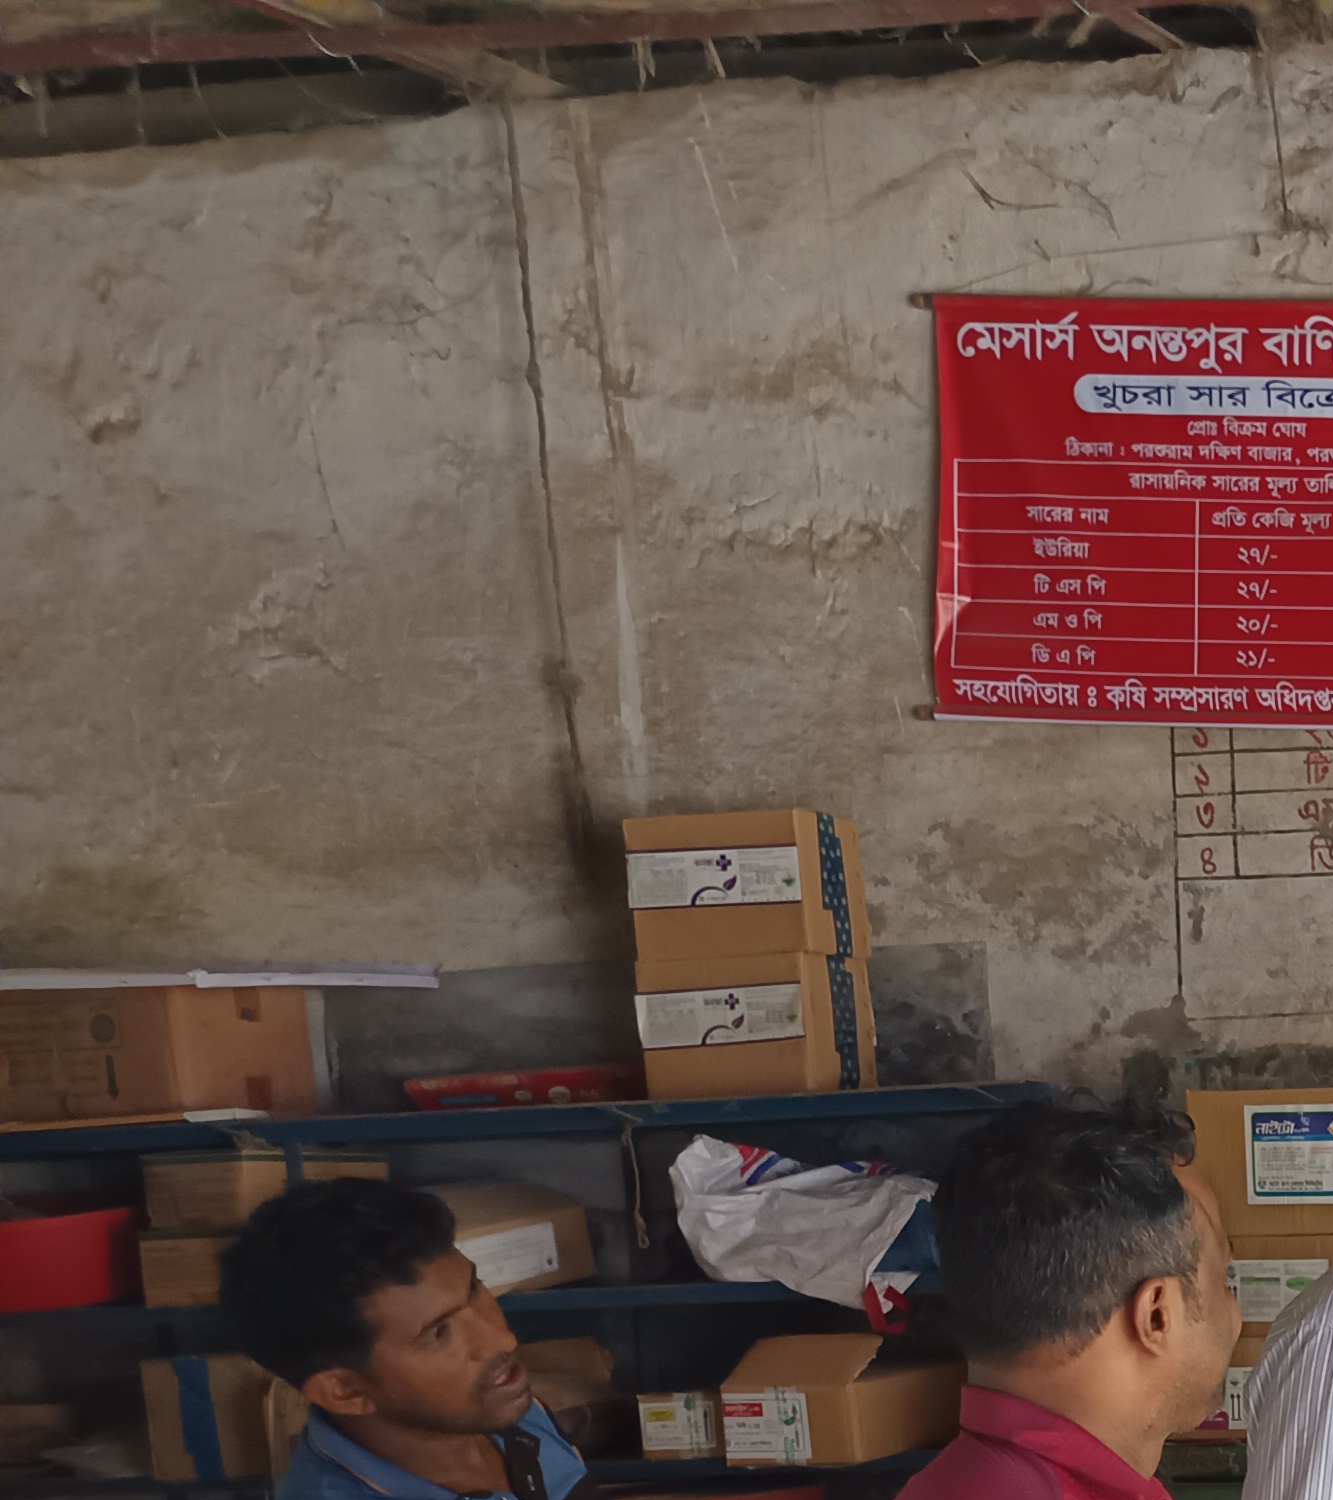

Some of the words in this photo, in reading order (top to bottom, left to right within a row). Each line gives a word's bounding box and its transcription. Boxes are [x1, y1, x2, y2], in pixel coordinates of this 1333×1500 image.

[957, 311, 1080, 361] মেসার্স
[1089, 323, 1250, 374] অনন্তপুর
[1094, 382, 1175, 411] খুচরা
[1187, 384, 1250, 408] সার
[1198, 440, 1241, 461] দক্ষিণ
[1212, 475, 1259, 492] সারের
[1266, 476, 1299, 498] মূল্য
[1026, 505, 1073, 523] সারের
[1080, 507, 1110, 524] নাম
[1212, 506, 1246, 528] প্রতি
[1252, 508, 1296, 529] কেজি
[1301, 513, 1331, 534] মূল্য
[1033, 536, 1090, 559] ইউরিয়া
[1237, 545, 1278, 566] ২৭/-
[1033, 573, 1050, 594] টি
[1056, 578, 1082, 595] এস
[1087, 574, 1106, 596] পি
[1237, 579, 1277, 600] ২৭/-
[1033, 611, 1058, 629] এম
[1065, 613, 1078, 628] ও
[1083, 608, 1102, 630] পি
[1236, 614, 1278, 635] ২০/-
[1031, 643, 1050, 664] ডি
[1056, 649, 1070, 665] এ
[1077, 645, 1096, 665] পি
[1236, 648, 1275, 669] ২১/-
[952, 673, 1079, 706] সহযোগিতায়
[1105, 678, 1147, 710] কৃষি
[1153, 686, 1249, 712] সম্প্রসারণ
